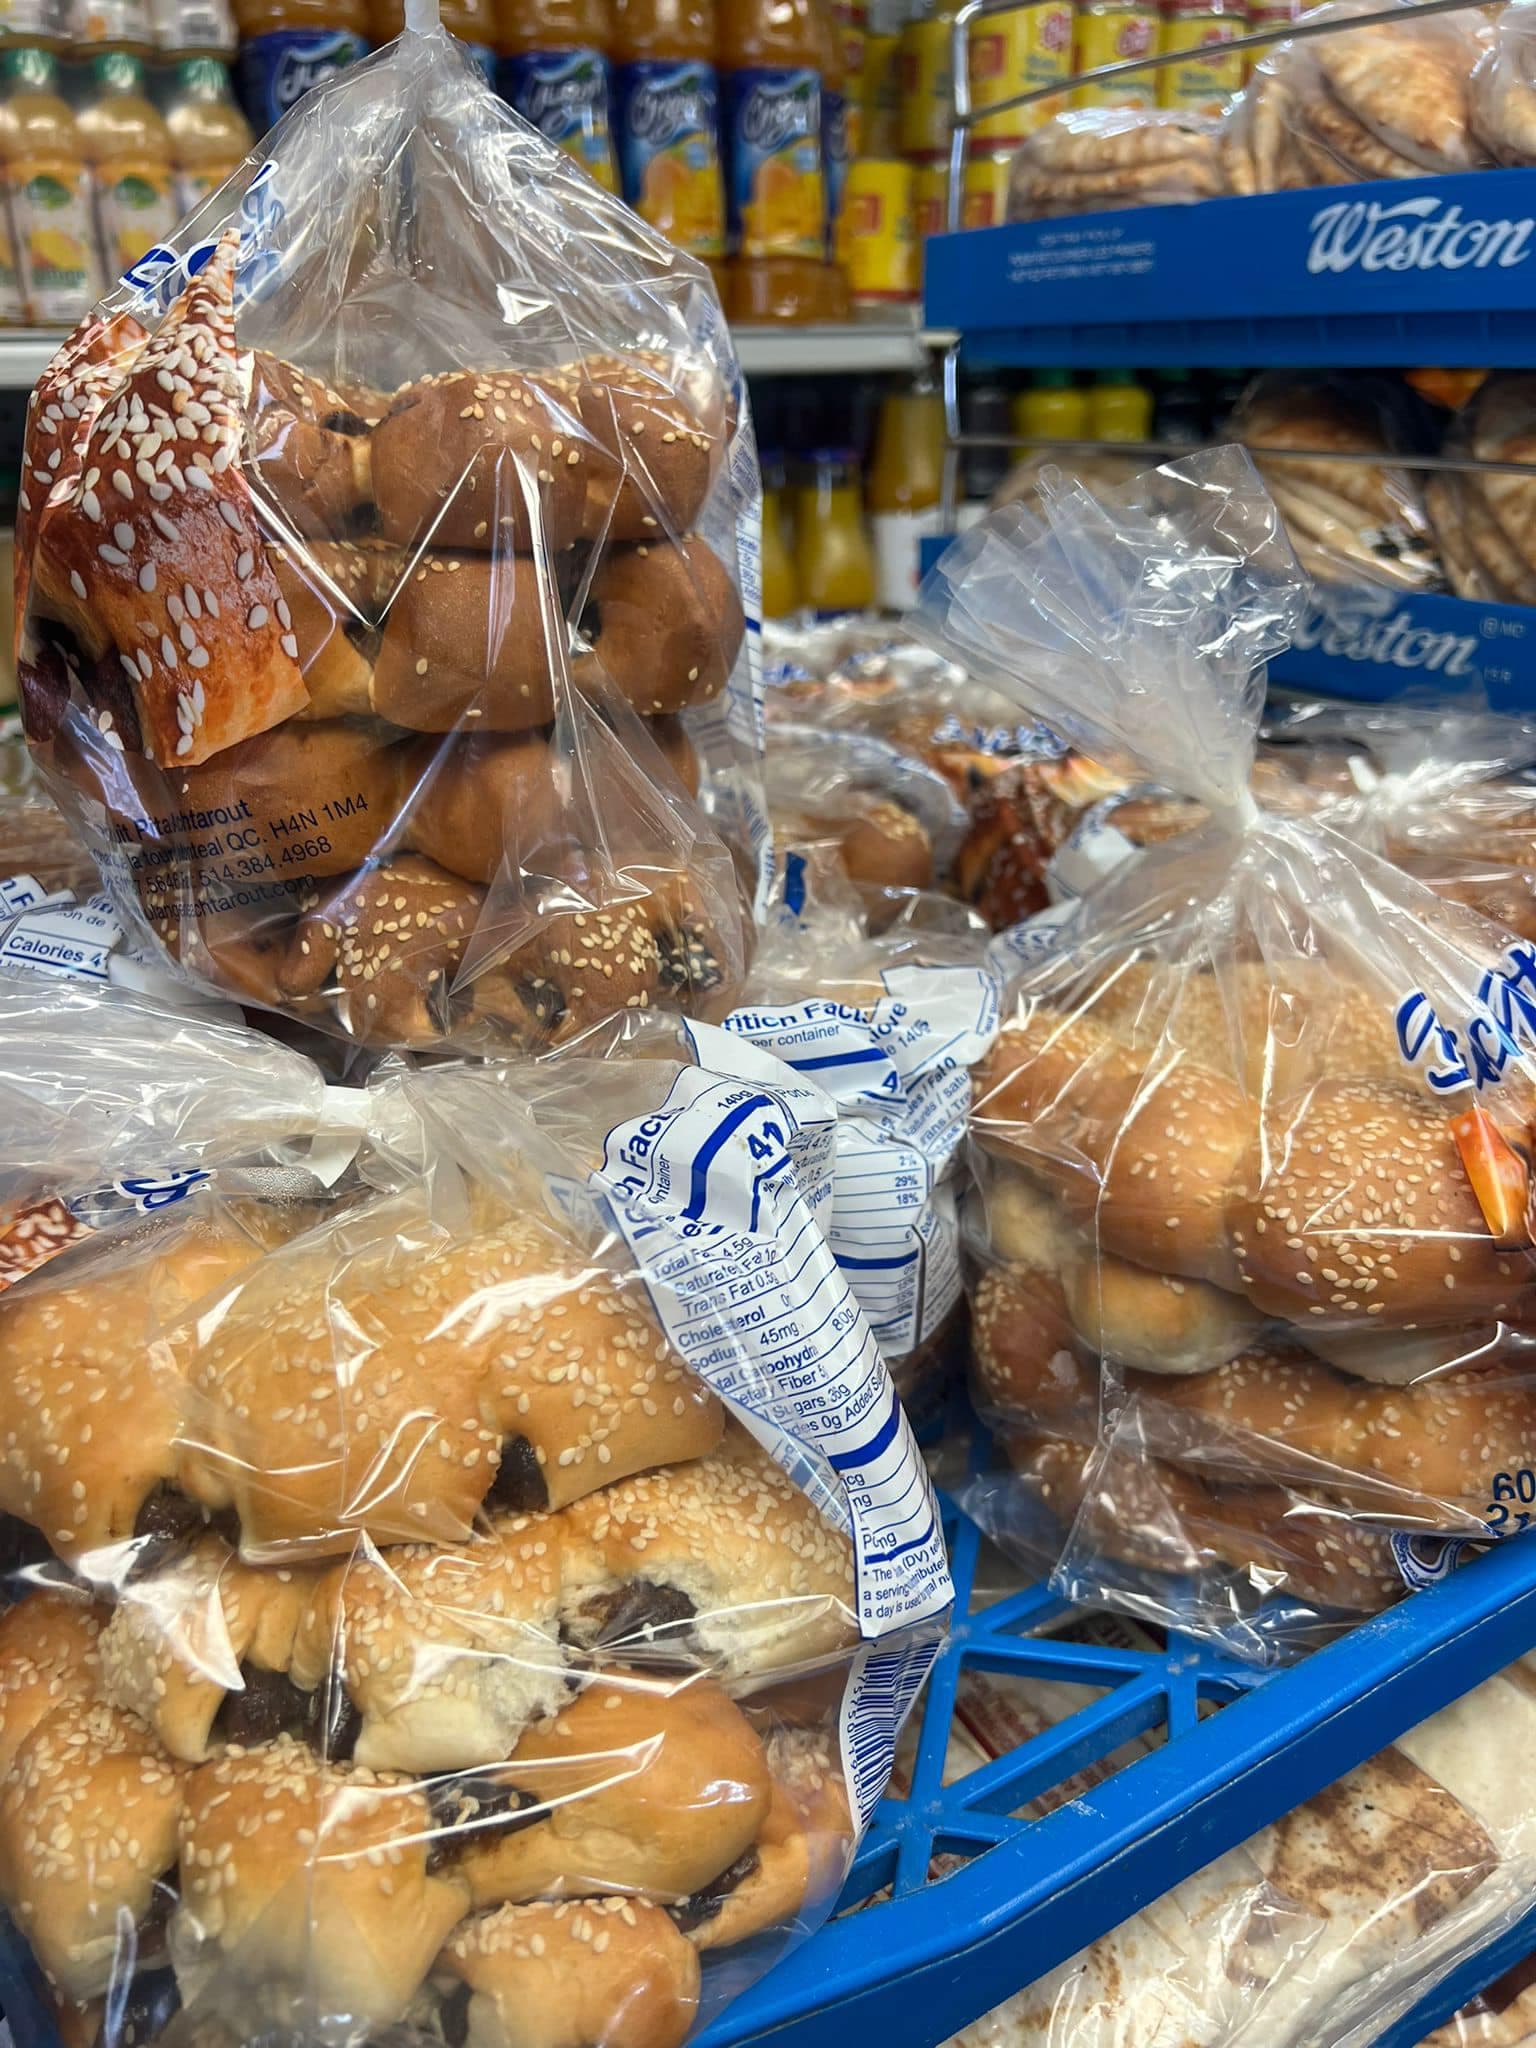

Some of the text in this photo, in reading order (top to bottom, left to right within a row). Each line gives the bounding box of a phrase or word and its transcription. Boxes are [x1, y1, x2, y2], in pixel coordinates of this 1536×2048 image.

[1307, 196, 1536, 274] Weston
[226, 827, 268, 853] QC.
[268, 811, 319, 839] H4N
[321, 793, 369, 822] 1M4
[9, 936, 84, 962] Calories
[776, 1025, 841, 1048] container
[717, 1089, 754, 1111] 140g
[894, 1174, 918, 1188] 29%
[896, 1191, 919, 1204] 18%
[683, 1291, 728, 1318] Trans
[728, 1279, 756, 1301] Fat
[831, 1307, 855, 1332] 80g
[759, 1320, 800, 1348] 45mg
[777, 1370, 818, 1392] Fiber
[821, 1414, 843, 1430] 0g
[844, 1382, 874, 1422] Added
[872, 1567, 893, 1583] The
[902, 1548, 930, 1570] (DV)
[863, 1590, 872, 1601] a
[864, 1607, 872, 1618] a
[876, 1603, 894, 1619] day
